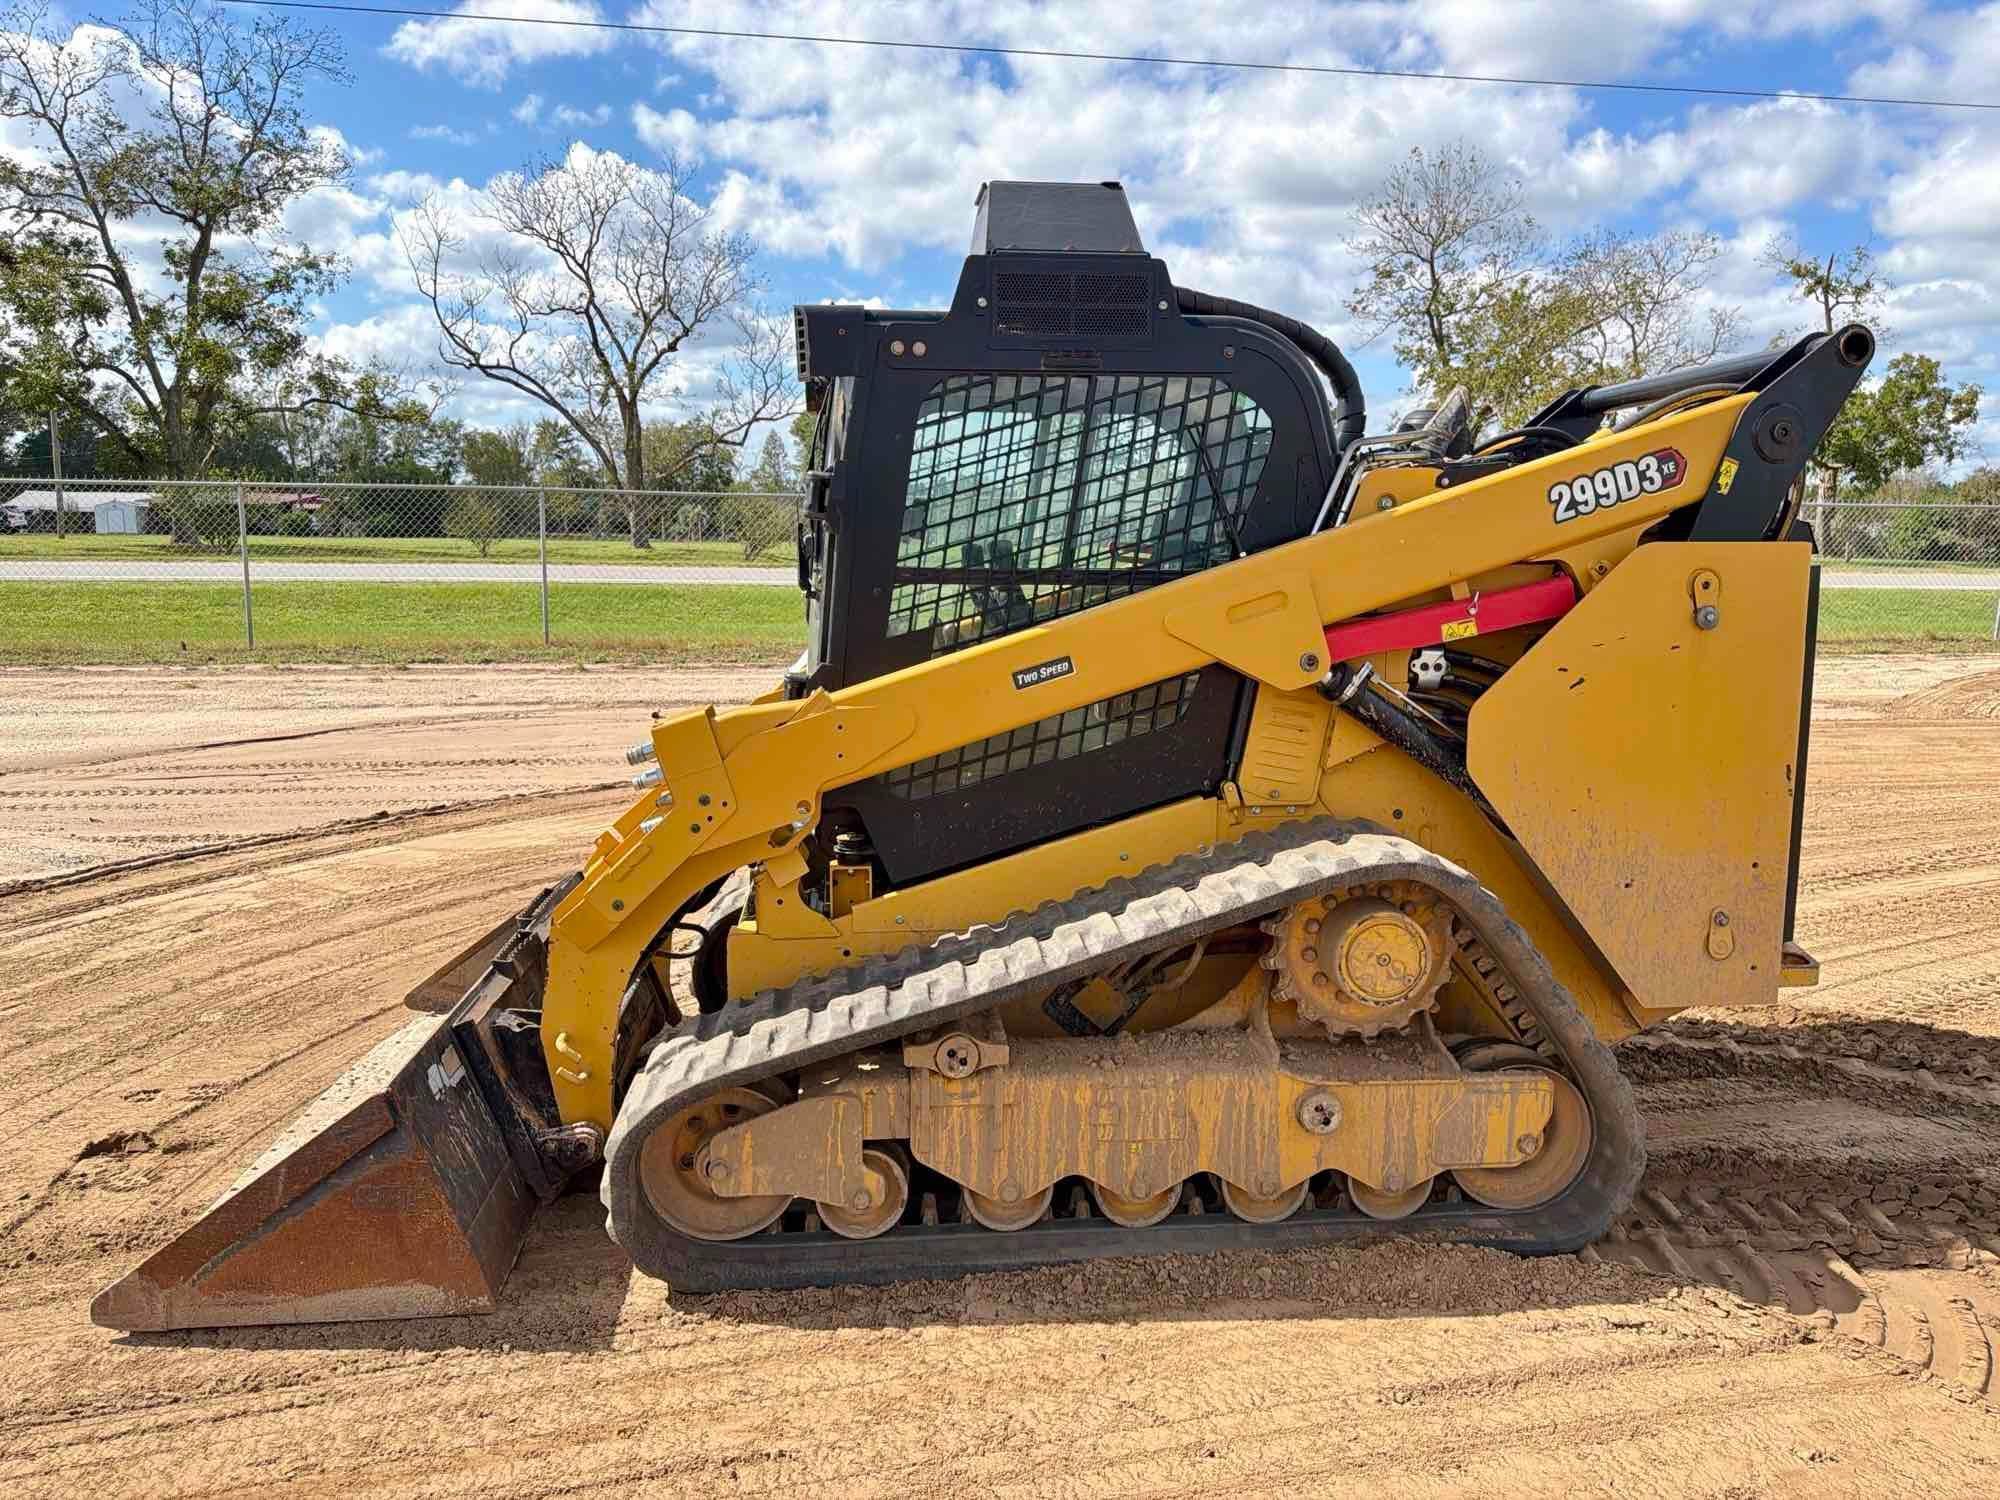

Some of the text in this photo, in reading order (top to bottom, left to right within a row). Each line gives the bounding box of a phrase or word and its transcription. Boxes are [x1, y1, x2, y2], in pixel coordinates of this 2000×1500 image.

[1550, 455, 1677, 522] 299D3 XE
[1017, 661, 1069, 685] TWO SPEED
